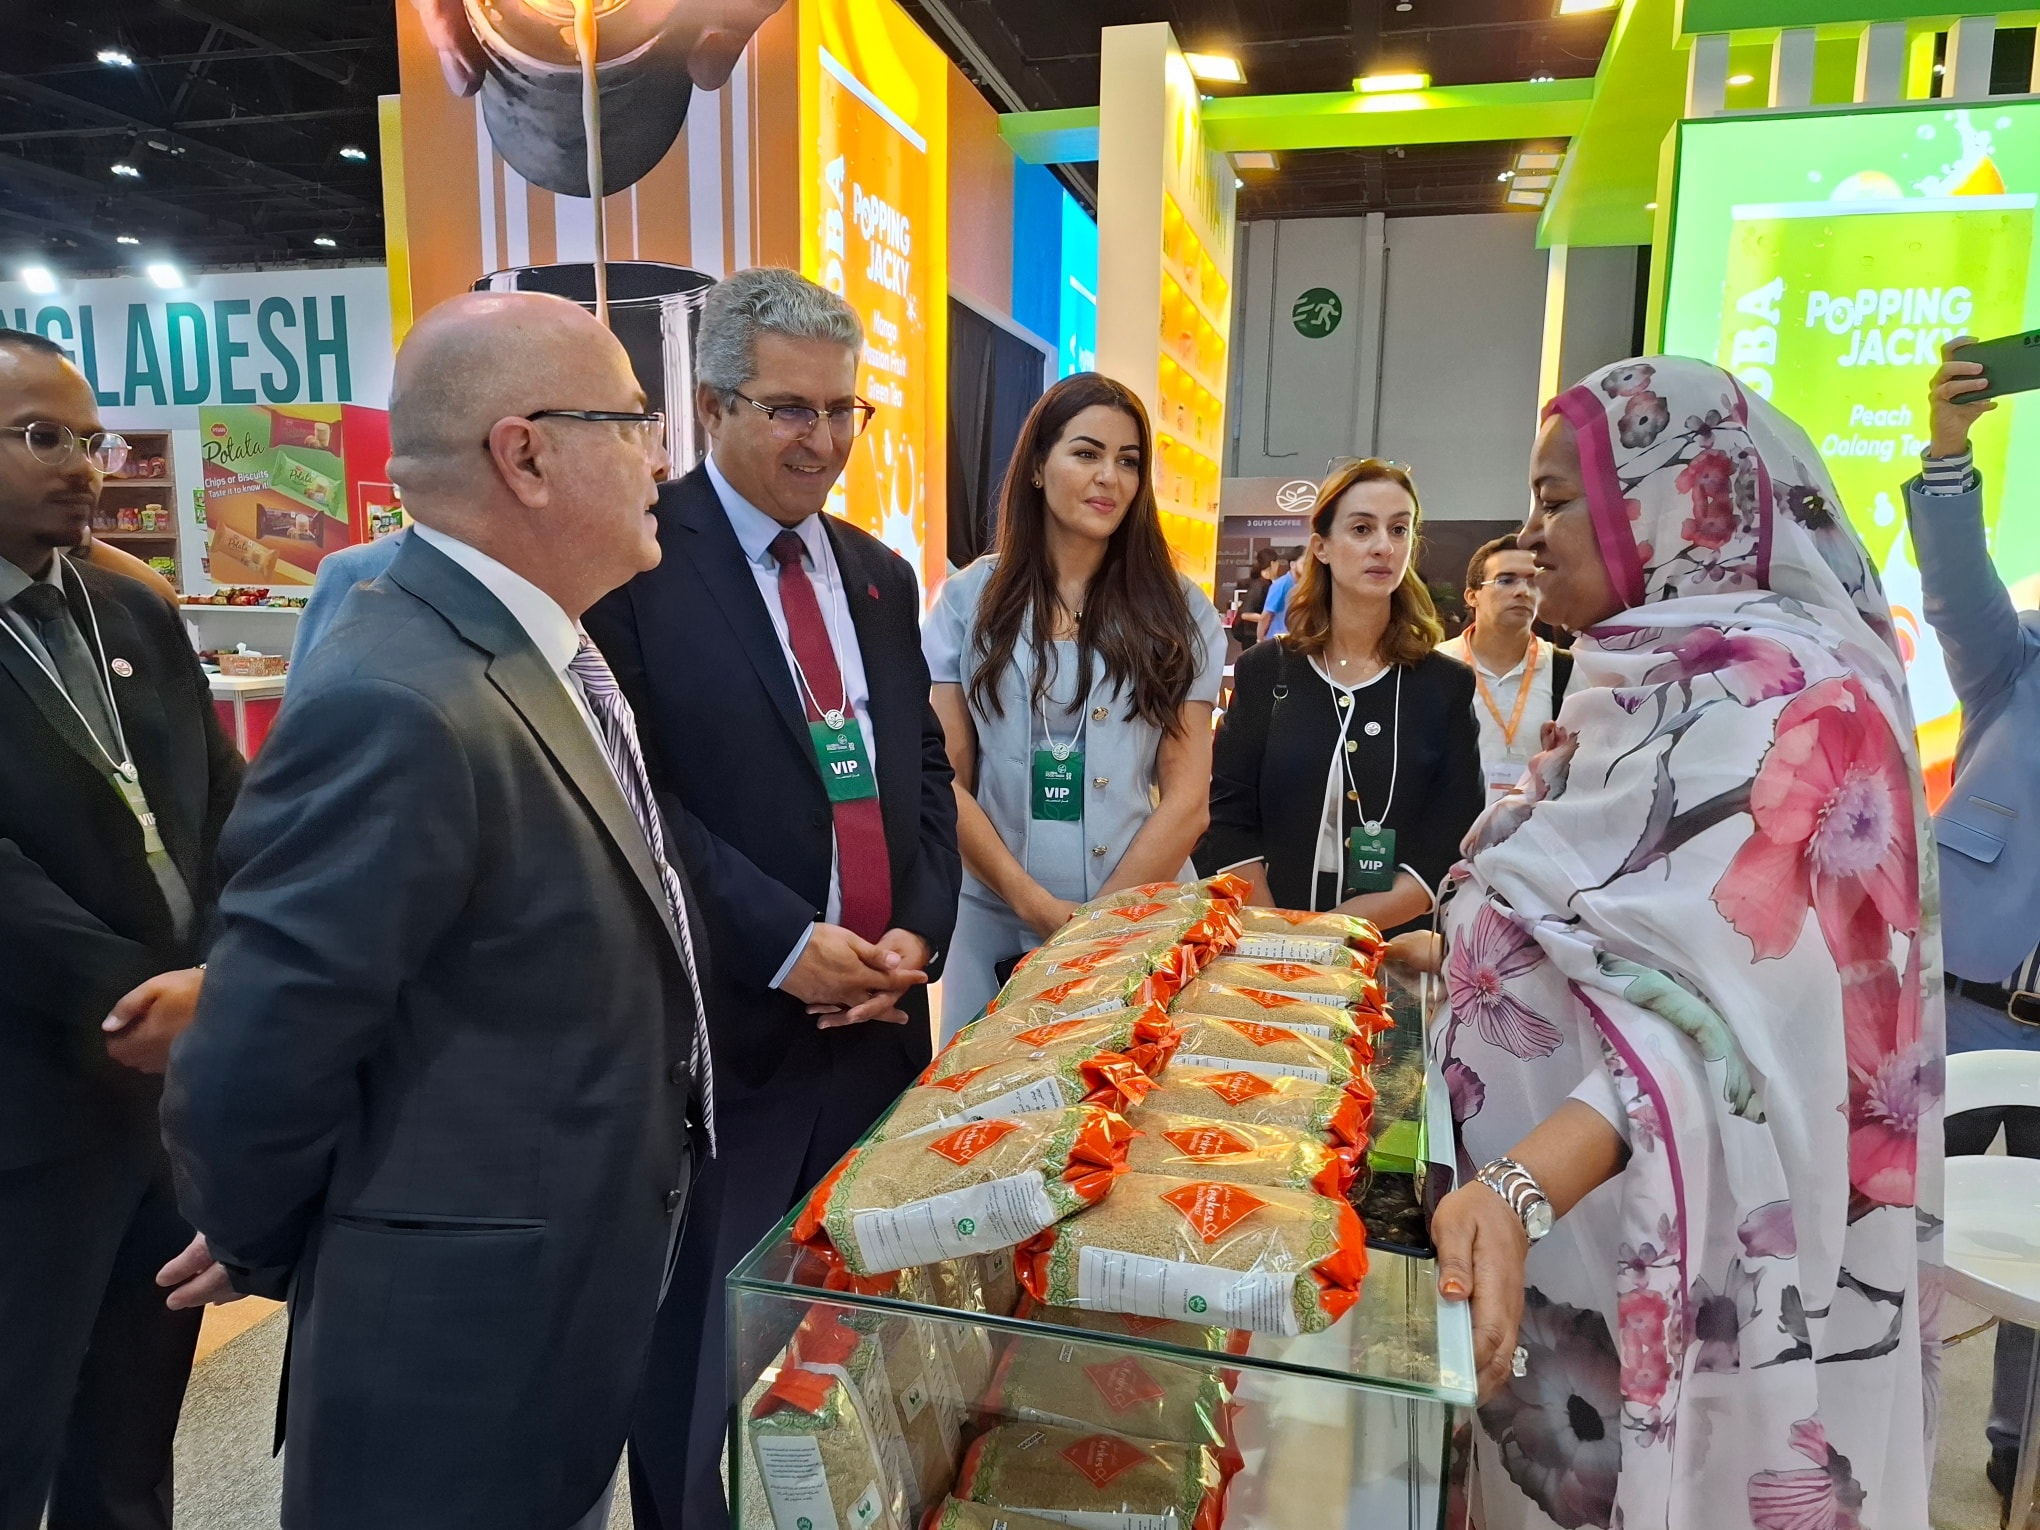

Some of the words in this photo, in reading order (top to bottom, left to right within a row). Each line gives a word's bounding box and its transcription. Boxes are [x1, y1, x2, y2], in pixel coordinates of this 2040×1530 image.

[853, 182, 910, 257] POPPING
[867, 240, 910, 297] JACKY
[1805, 286, 1973, 335] POPPING
[1850, 404, 1912, 427] Peach
[203, 432, 265, 467] Potata
[1822, 434, 1898, 462] Oolong
[205, 477, 226, 489] Chips
[237, 470, 269, 483] Biscuits
[208, 489, 227, 498] Taste
[242, 485, 260, 493] know
[1273, 519, 1302, 527] COFFEE
[830, 760, 858, 775] VIP
[1044, 787, 1070, 799] VIP
[1359, 860, 1383, 870] VIP
